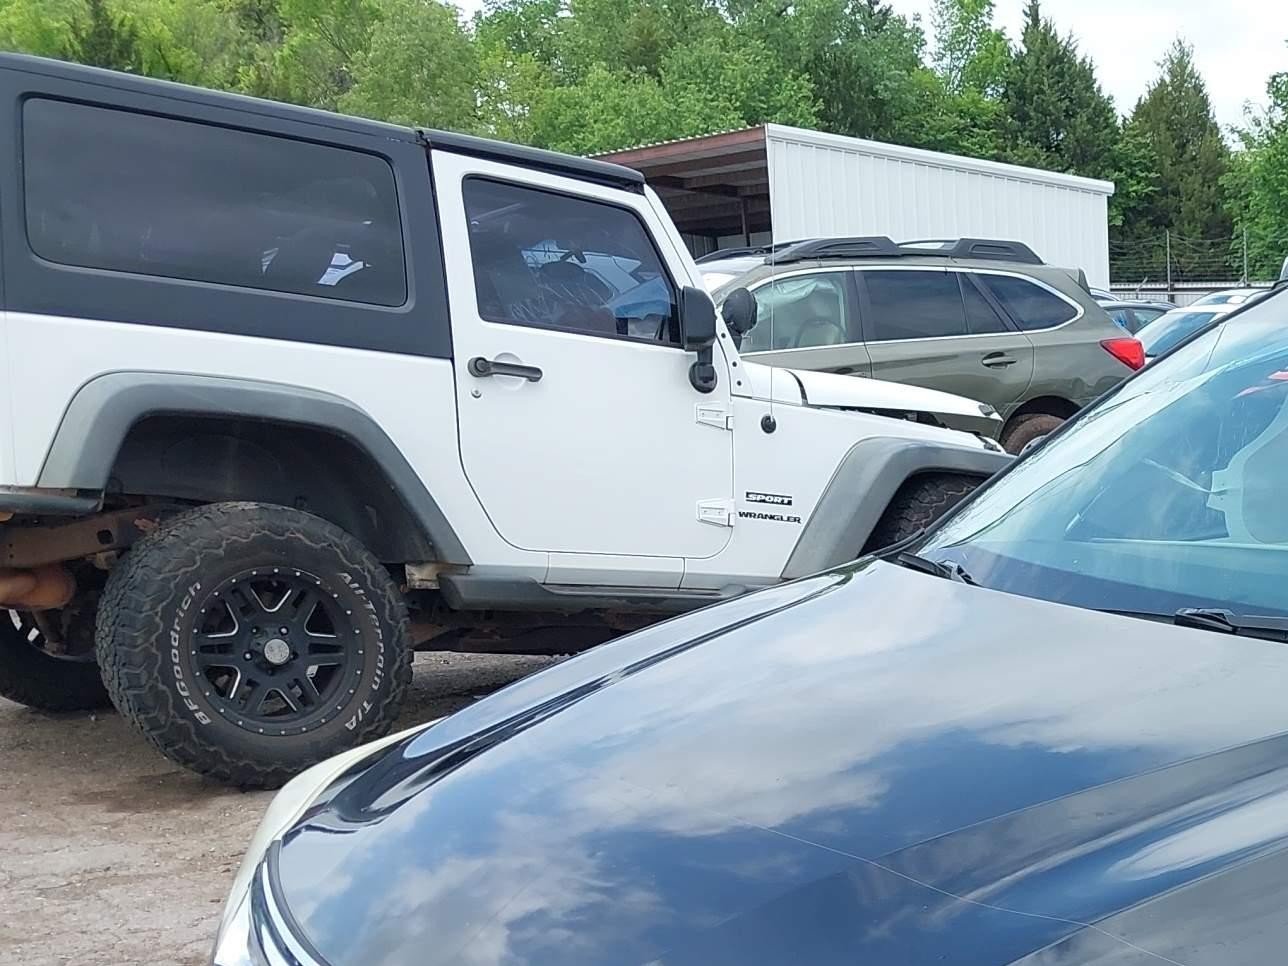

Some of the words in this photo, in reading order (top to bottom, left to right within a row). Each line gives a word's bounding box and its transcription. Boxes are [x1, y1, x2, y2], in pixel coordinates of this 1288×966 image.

[747, 493, 791, 505] SPORT
[738, 511, 802, 524] WRANGLER
[169, 581, 212, 726] BFGoodrich
